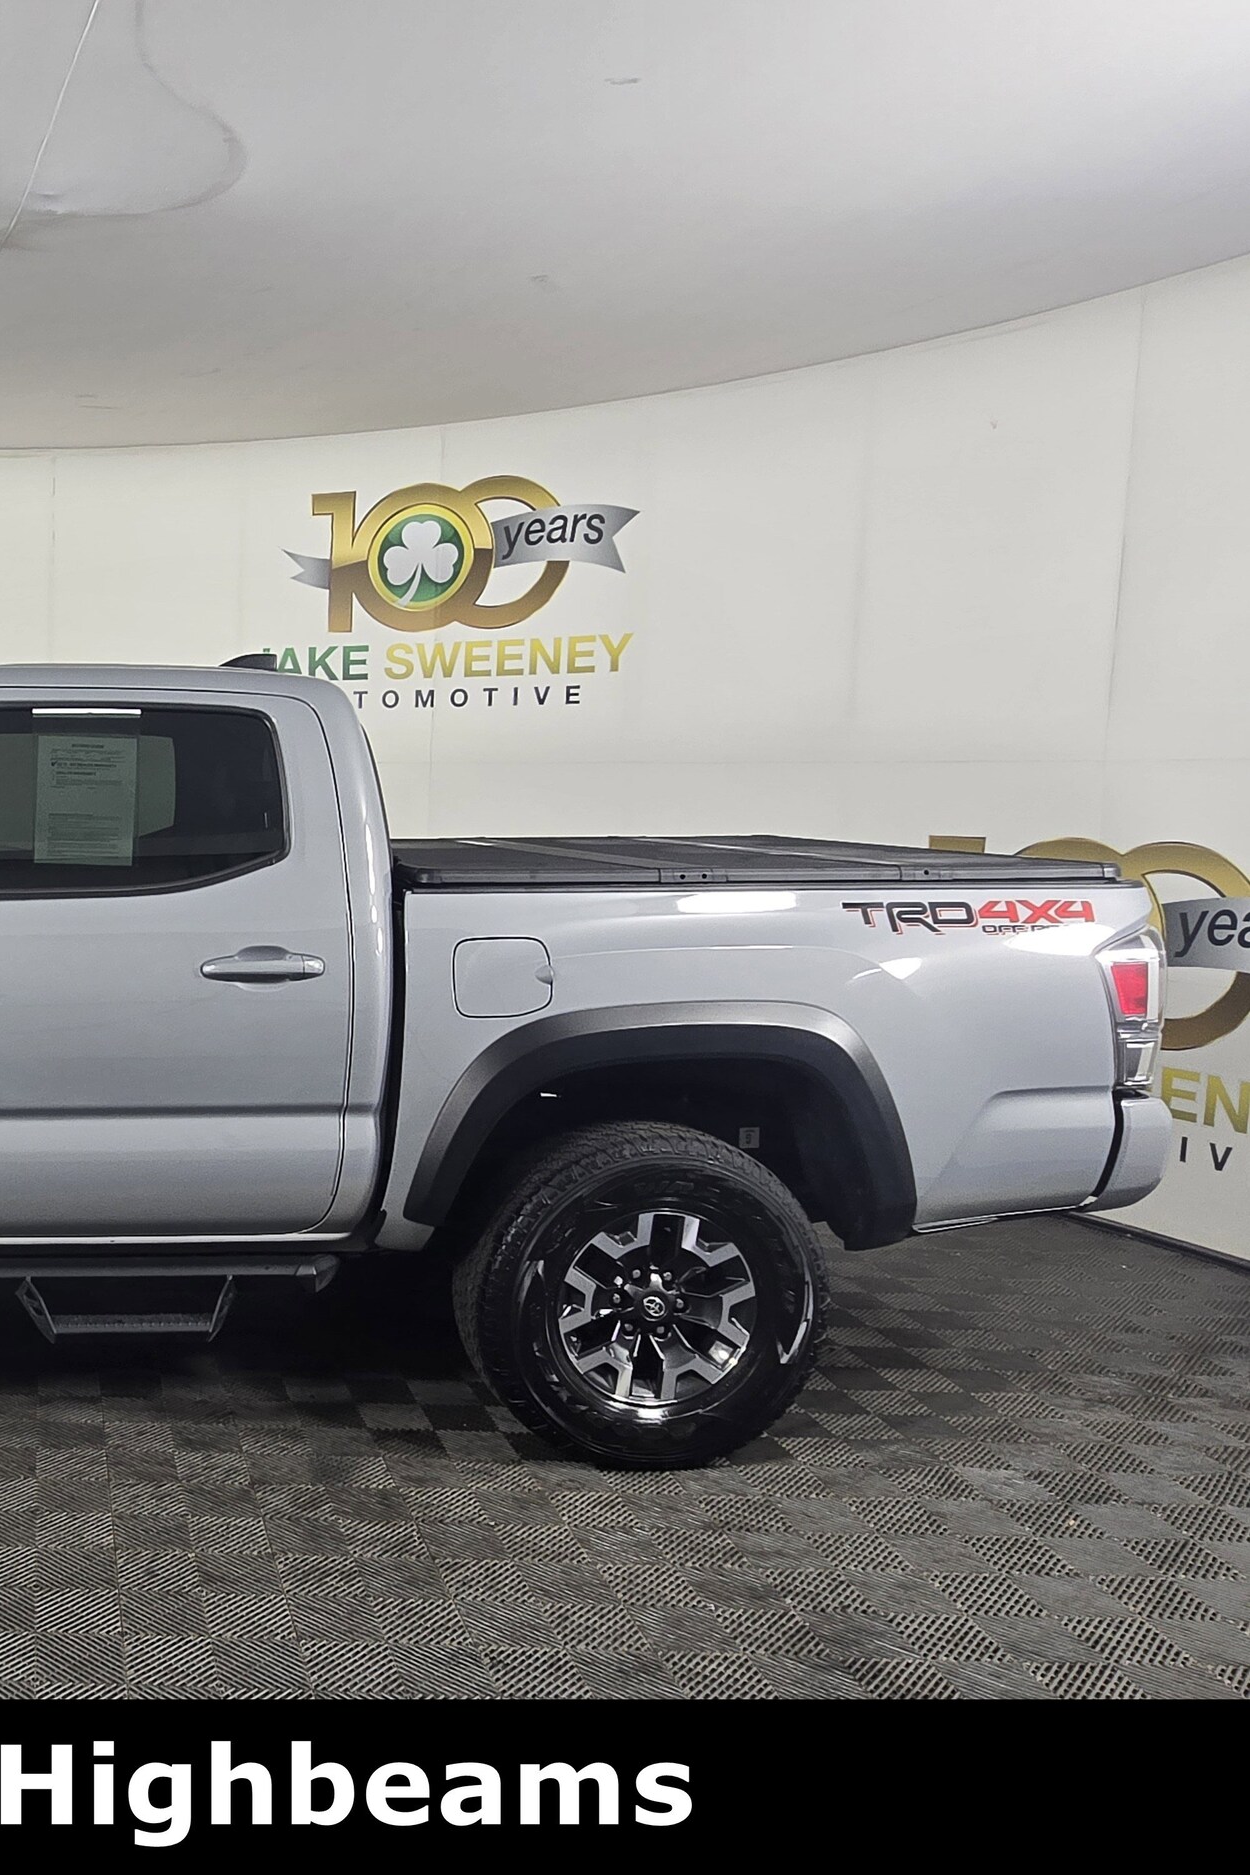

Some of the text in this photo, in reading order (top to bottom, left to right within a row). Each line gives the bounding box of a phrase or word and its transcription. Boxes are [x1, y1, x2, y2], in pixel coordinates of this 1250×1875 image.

[311, 474, 570, 633] 100
[500, 513, 606, 560] years
[263, 632, 634, 681] AKE SWEENEY
[352, 685, 581, 709] TOMOTIVE
